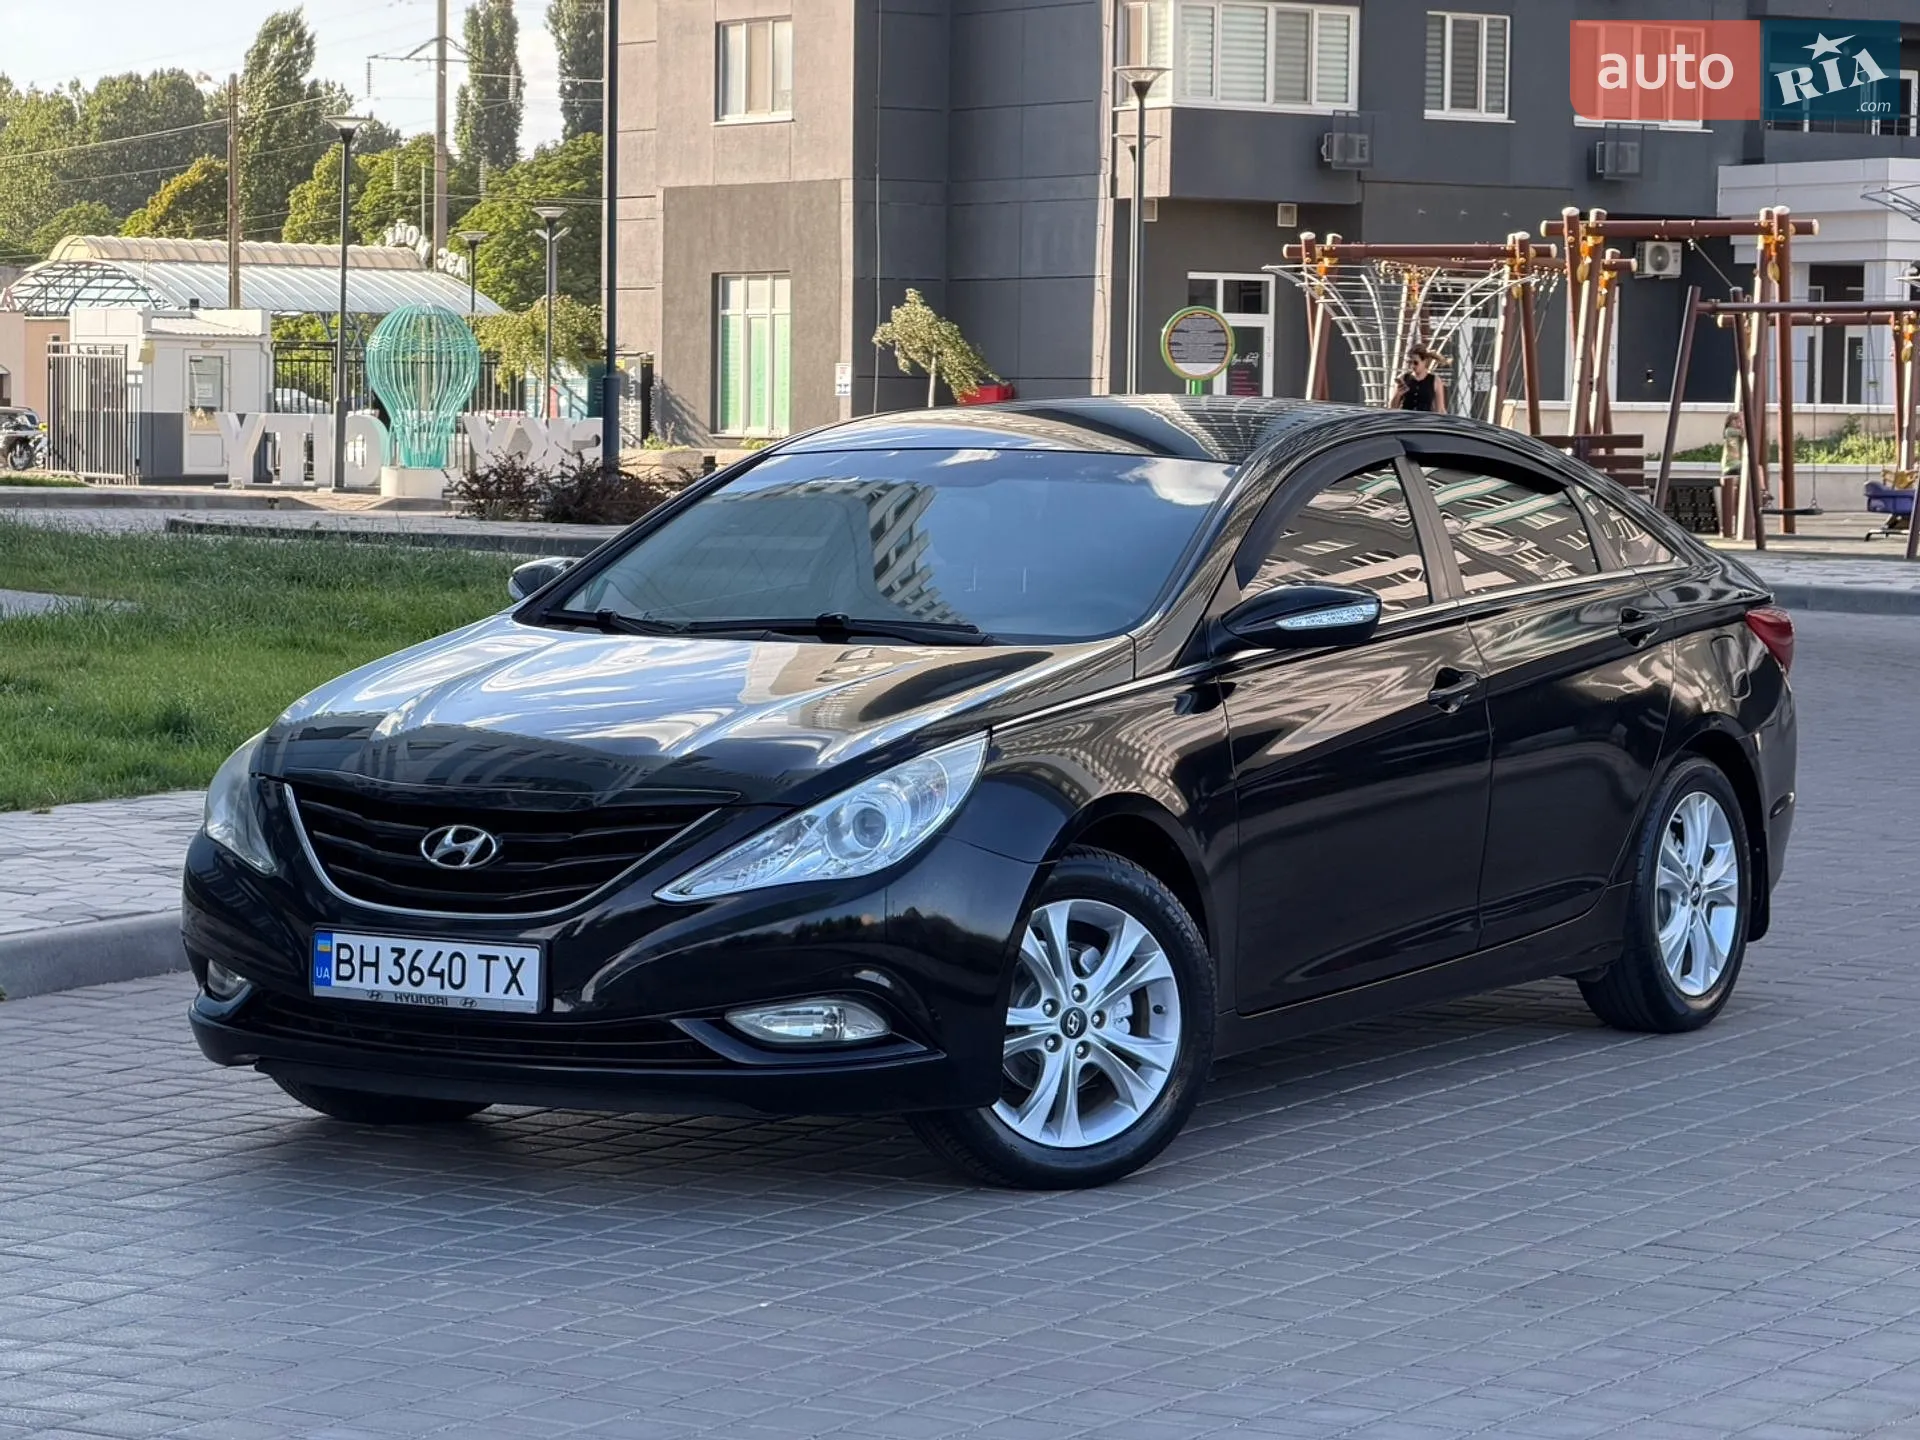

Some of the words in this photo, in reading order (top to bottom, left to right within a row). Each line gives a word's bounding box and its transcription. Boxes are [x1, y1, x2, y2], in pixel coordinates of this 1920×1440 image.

[316, 967, 330, 979] UA
[335, 943, 380, 984] BH
[388, 946, 467, 990] 3640
[477, 953, 526, 996] TX
[394, 993, 449, 1007] HYUNDAI
